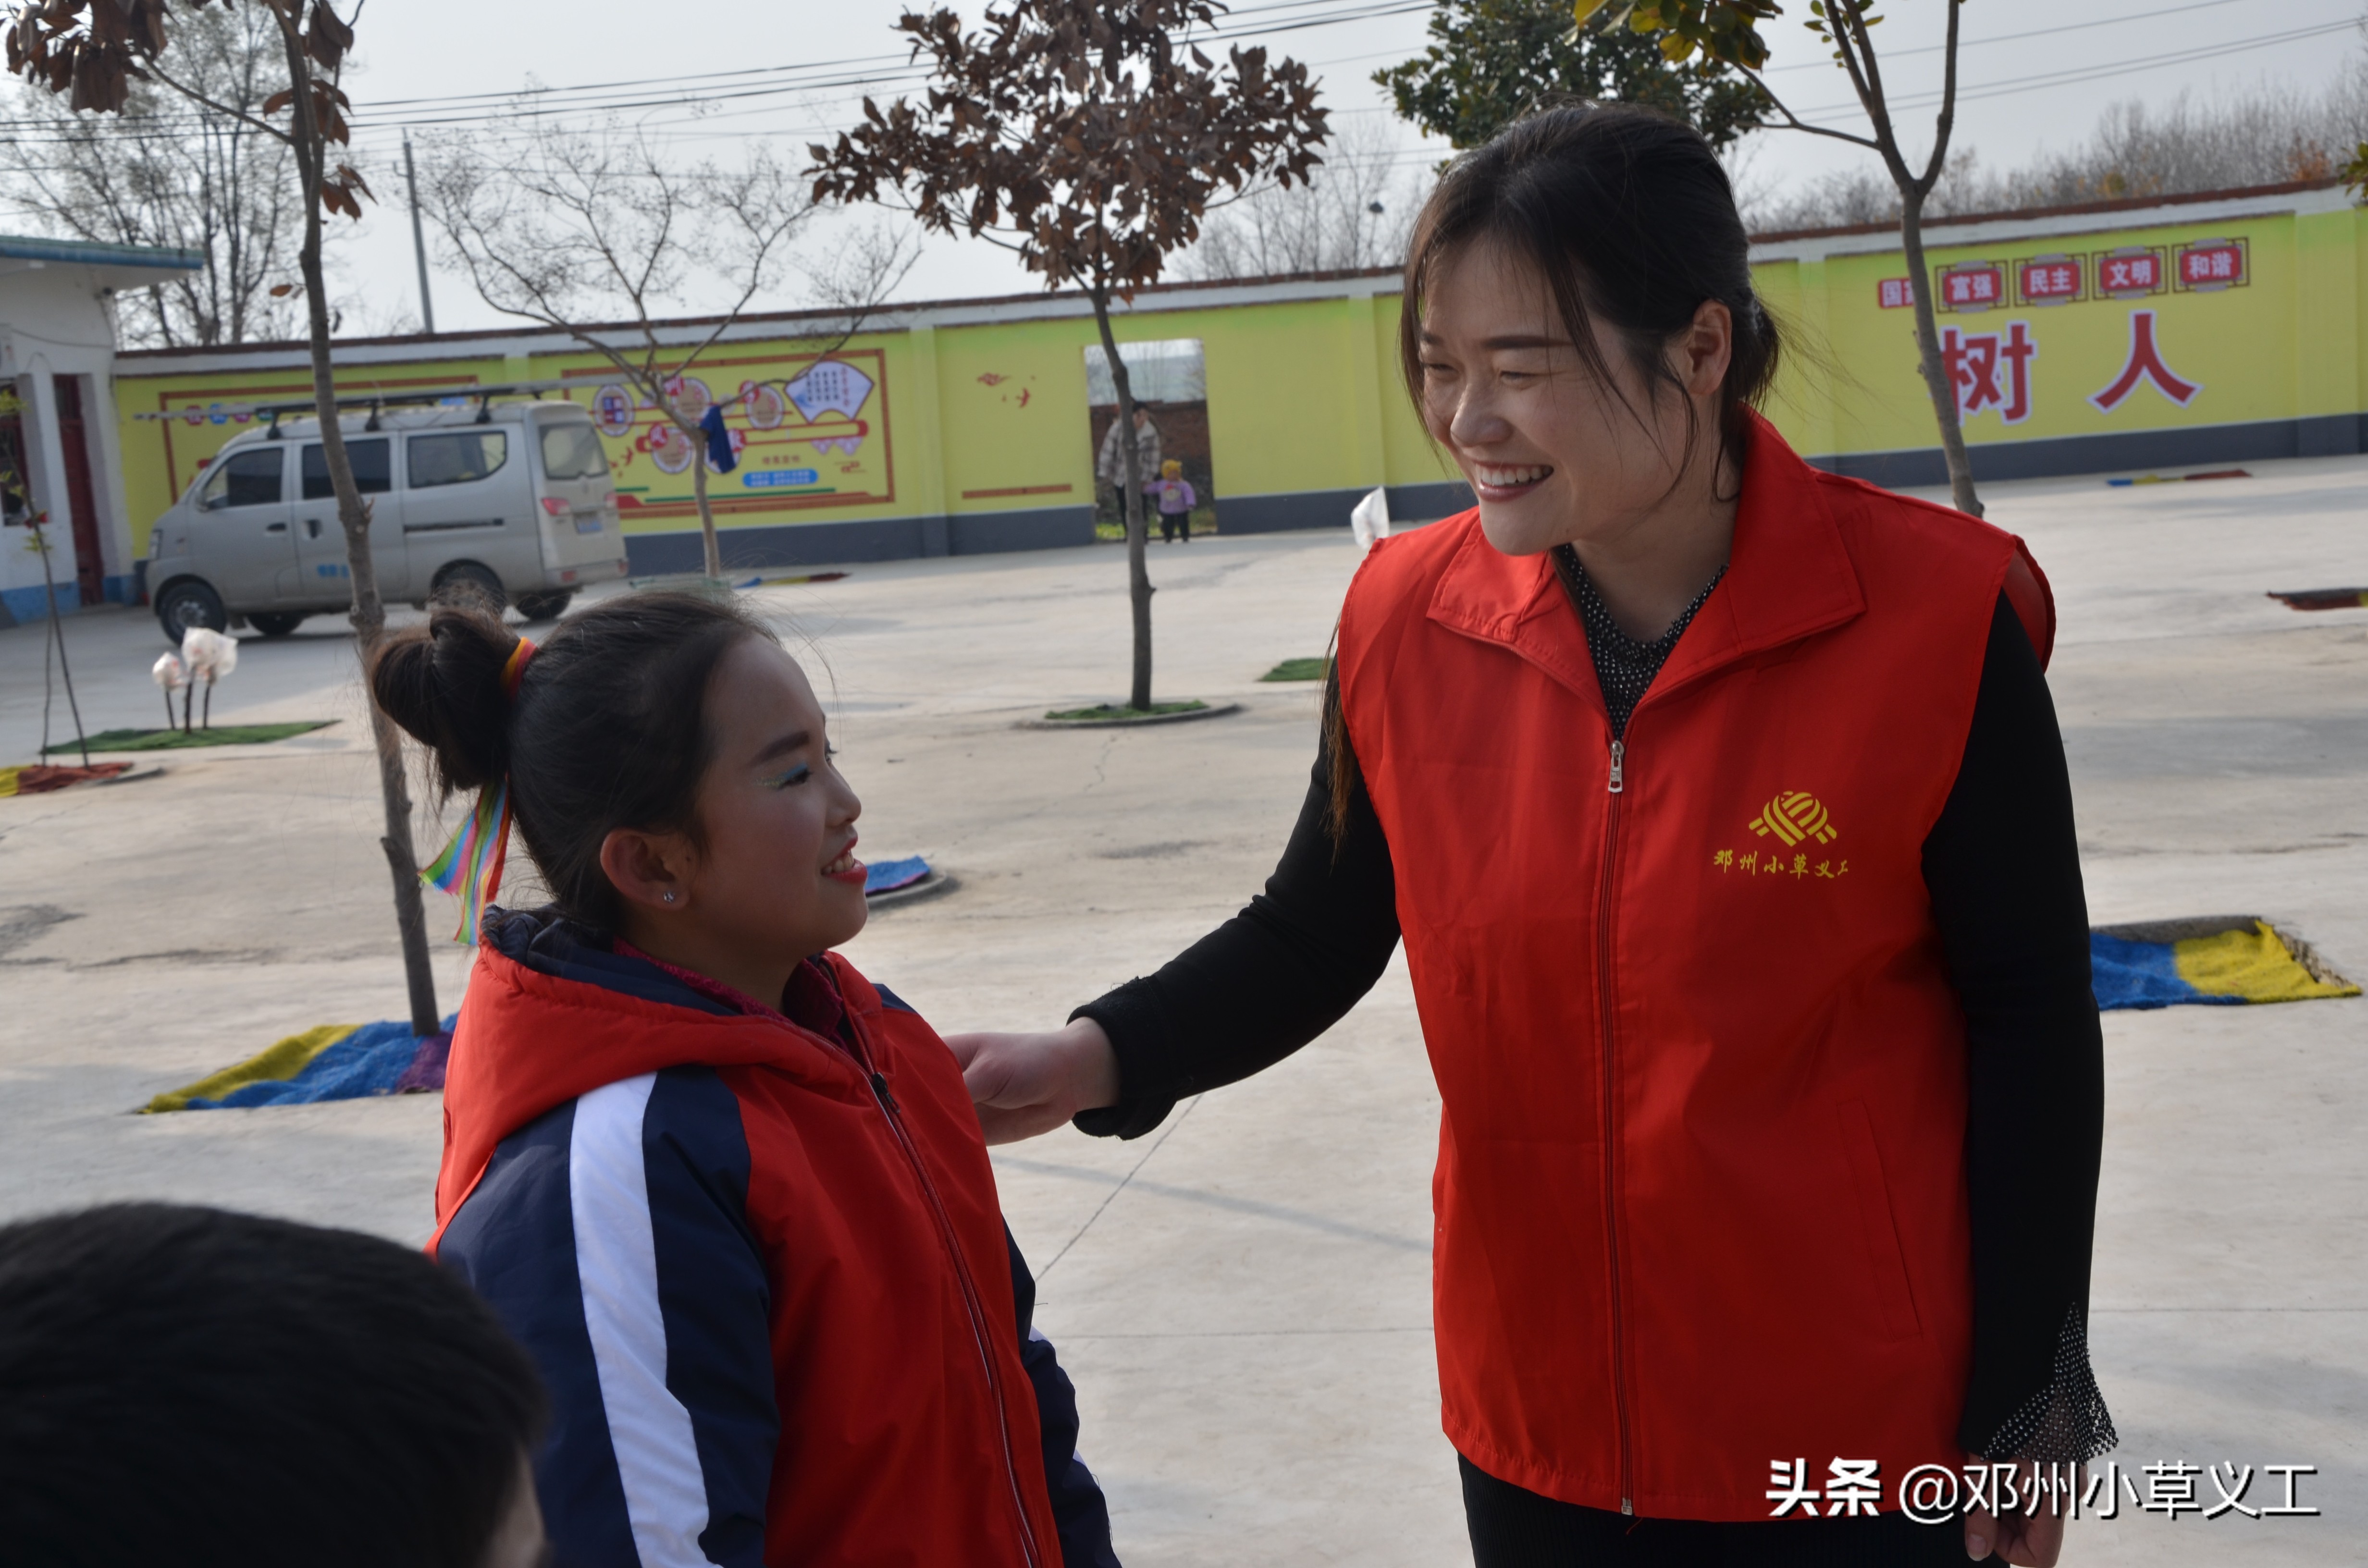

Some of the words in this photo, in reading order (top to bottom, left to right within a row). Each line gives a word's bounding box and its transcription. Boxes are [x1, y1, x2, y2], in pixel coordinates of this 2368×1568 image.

[1950, 273, 1993, 302] 富强
[2029, 267, 2072, 294] 民主
[2109, 259, 2152, 287] 文明
[2188, 251, 2233, 279] 和谐
[1714, 849, 1849, 880] 邓州小草义工
